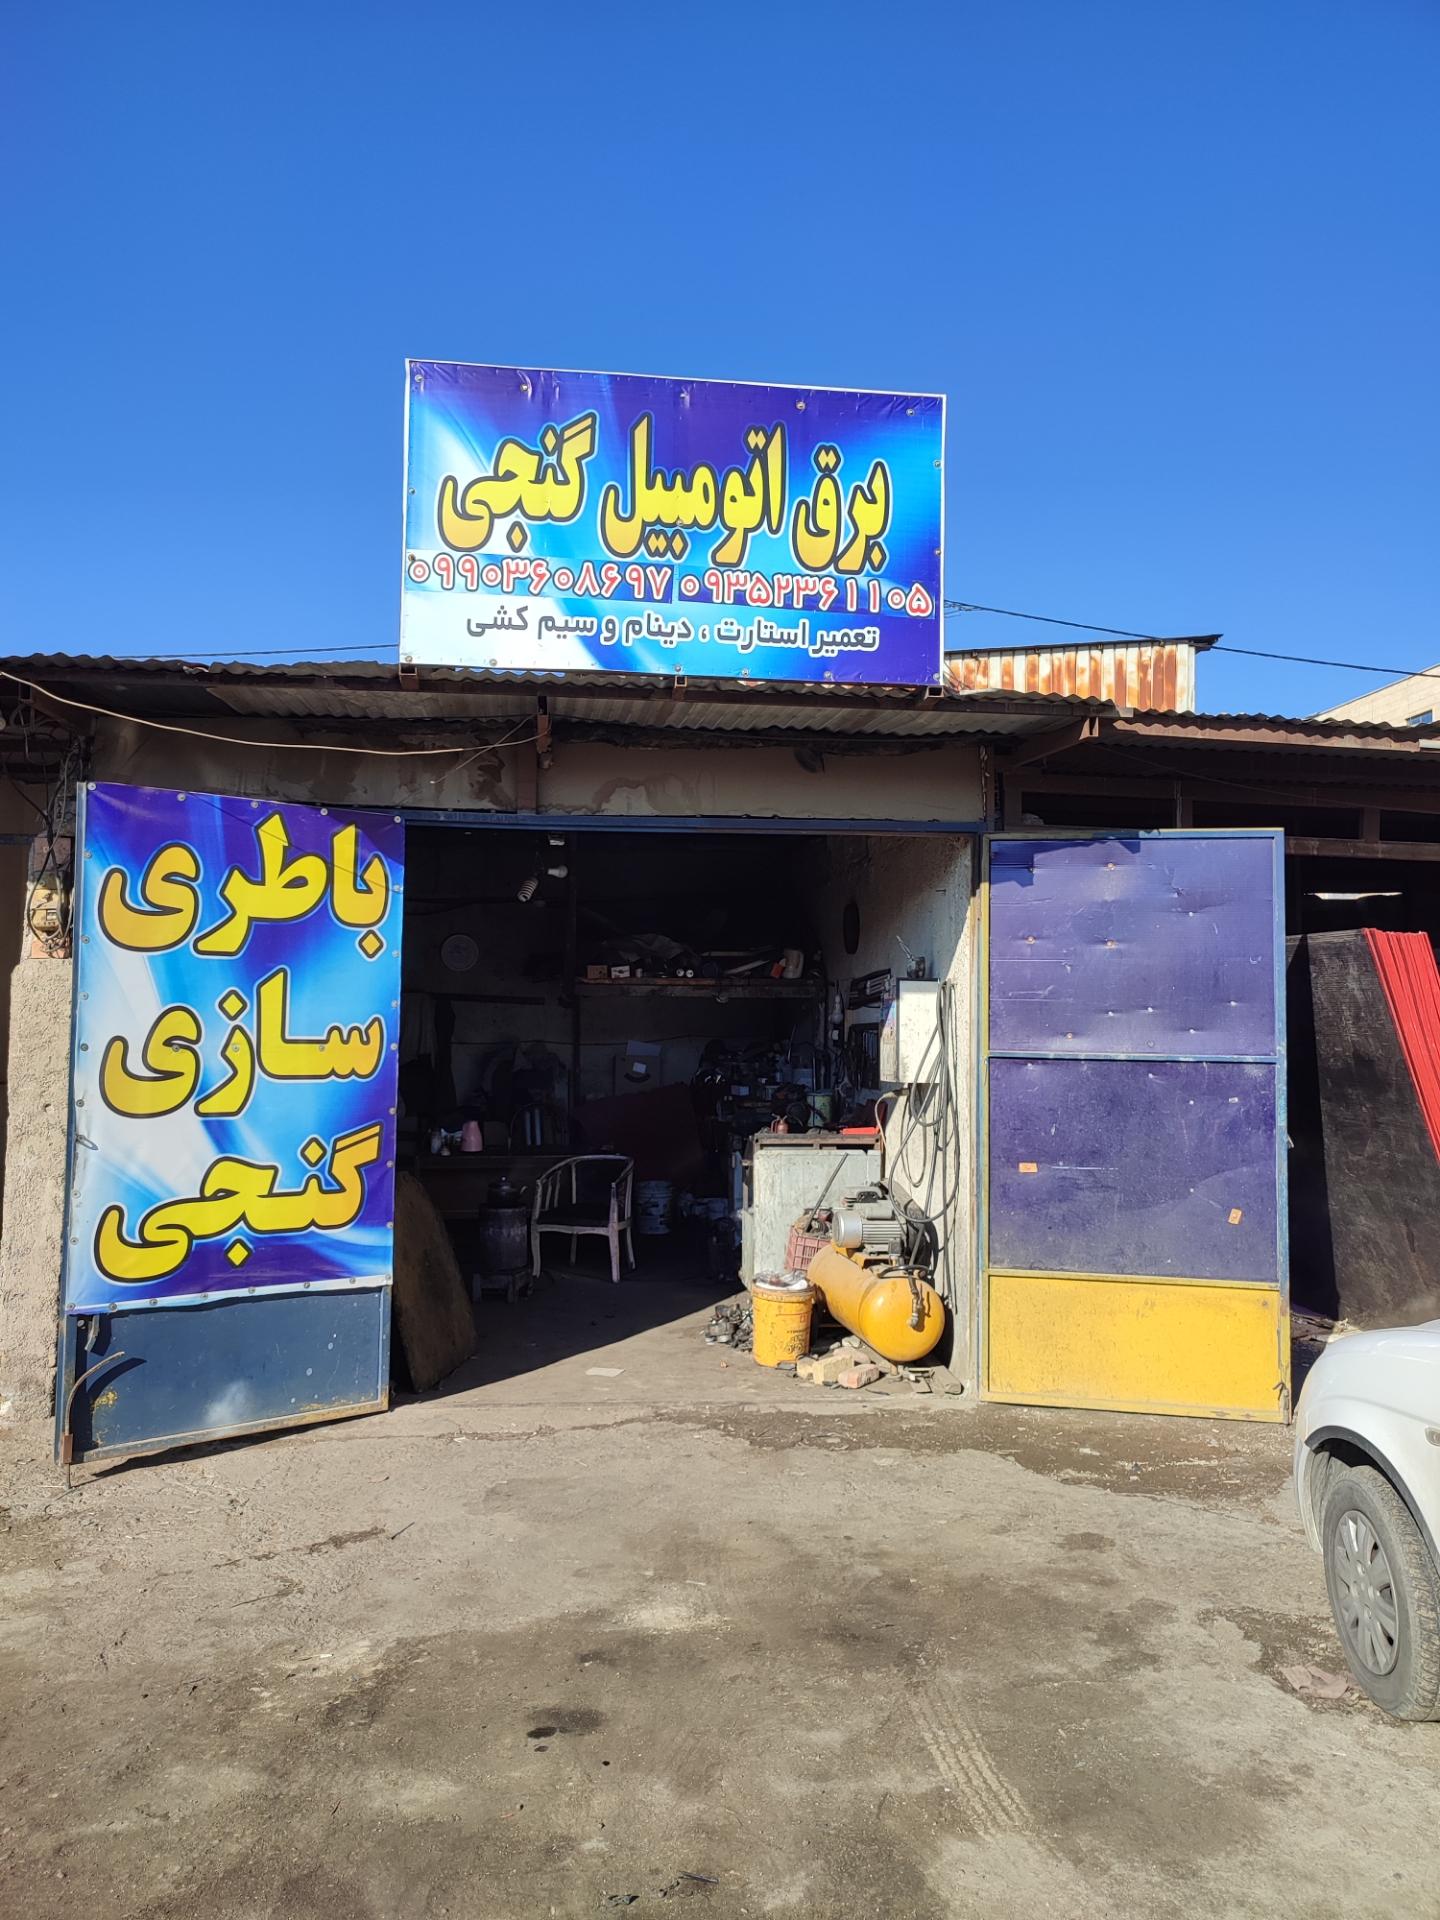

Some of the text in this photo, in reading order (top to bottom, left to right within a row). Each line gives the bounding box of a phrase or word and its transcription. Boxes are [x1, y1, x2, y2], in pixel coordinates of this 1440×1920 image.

[438, 410, 890, 571] برق اتومبیل گنجی
[466, 604, 529, 637] کشی
[537, 615, 594, 640] سیم
[603, 618, 616, 642] و
[625, 613, 692, 645] دینام
[717, 619, 806, 651] استارت
[811, 628, 877, 655] تعمیر
[98, 811, 389, 958] باطری
[99, 967, 384, 1117] سازی
[93, 1122, 384, 1283] گنجی
